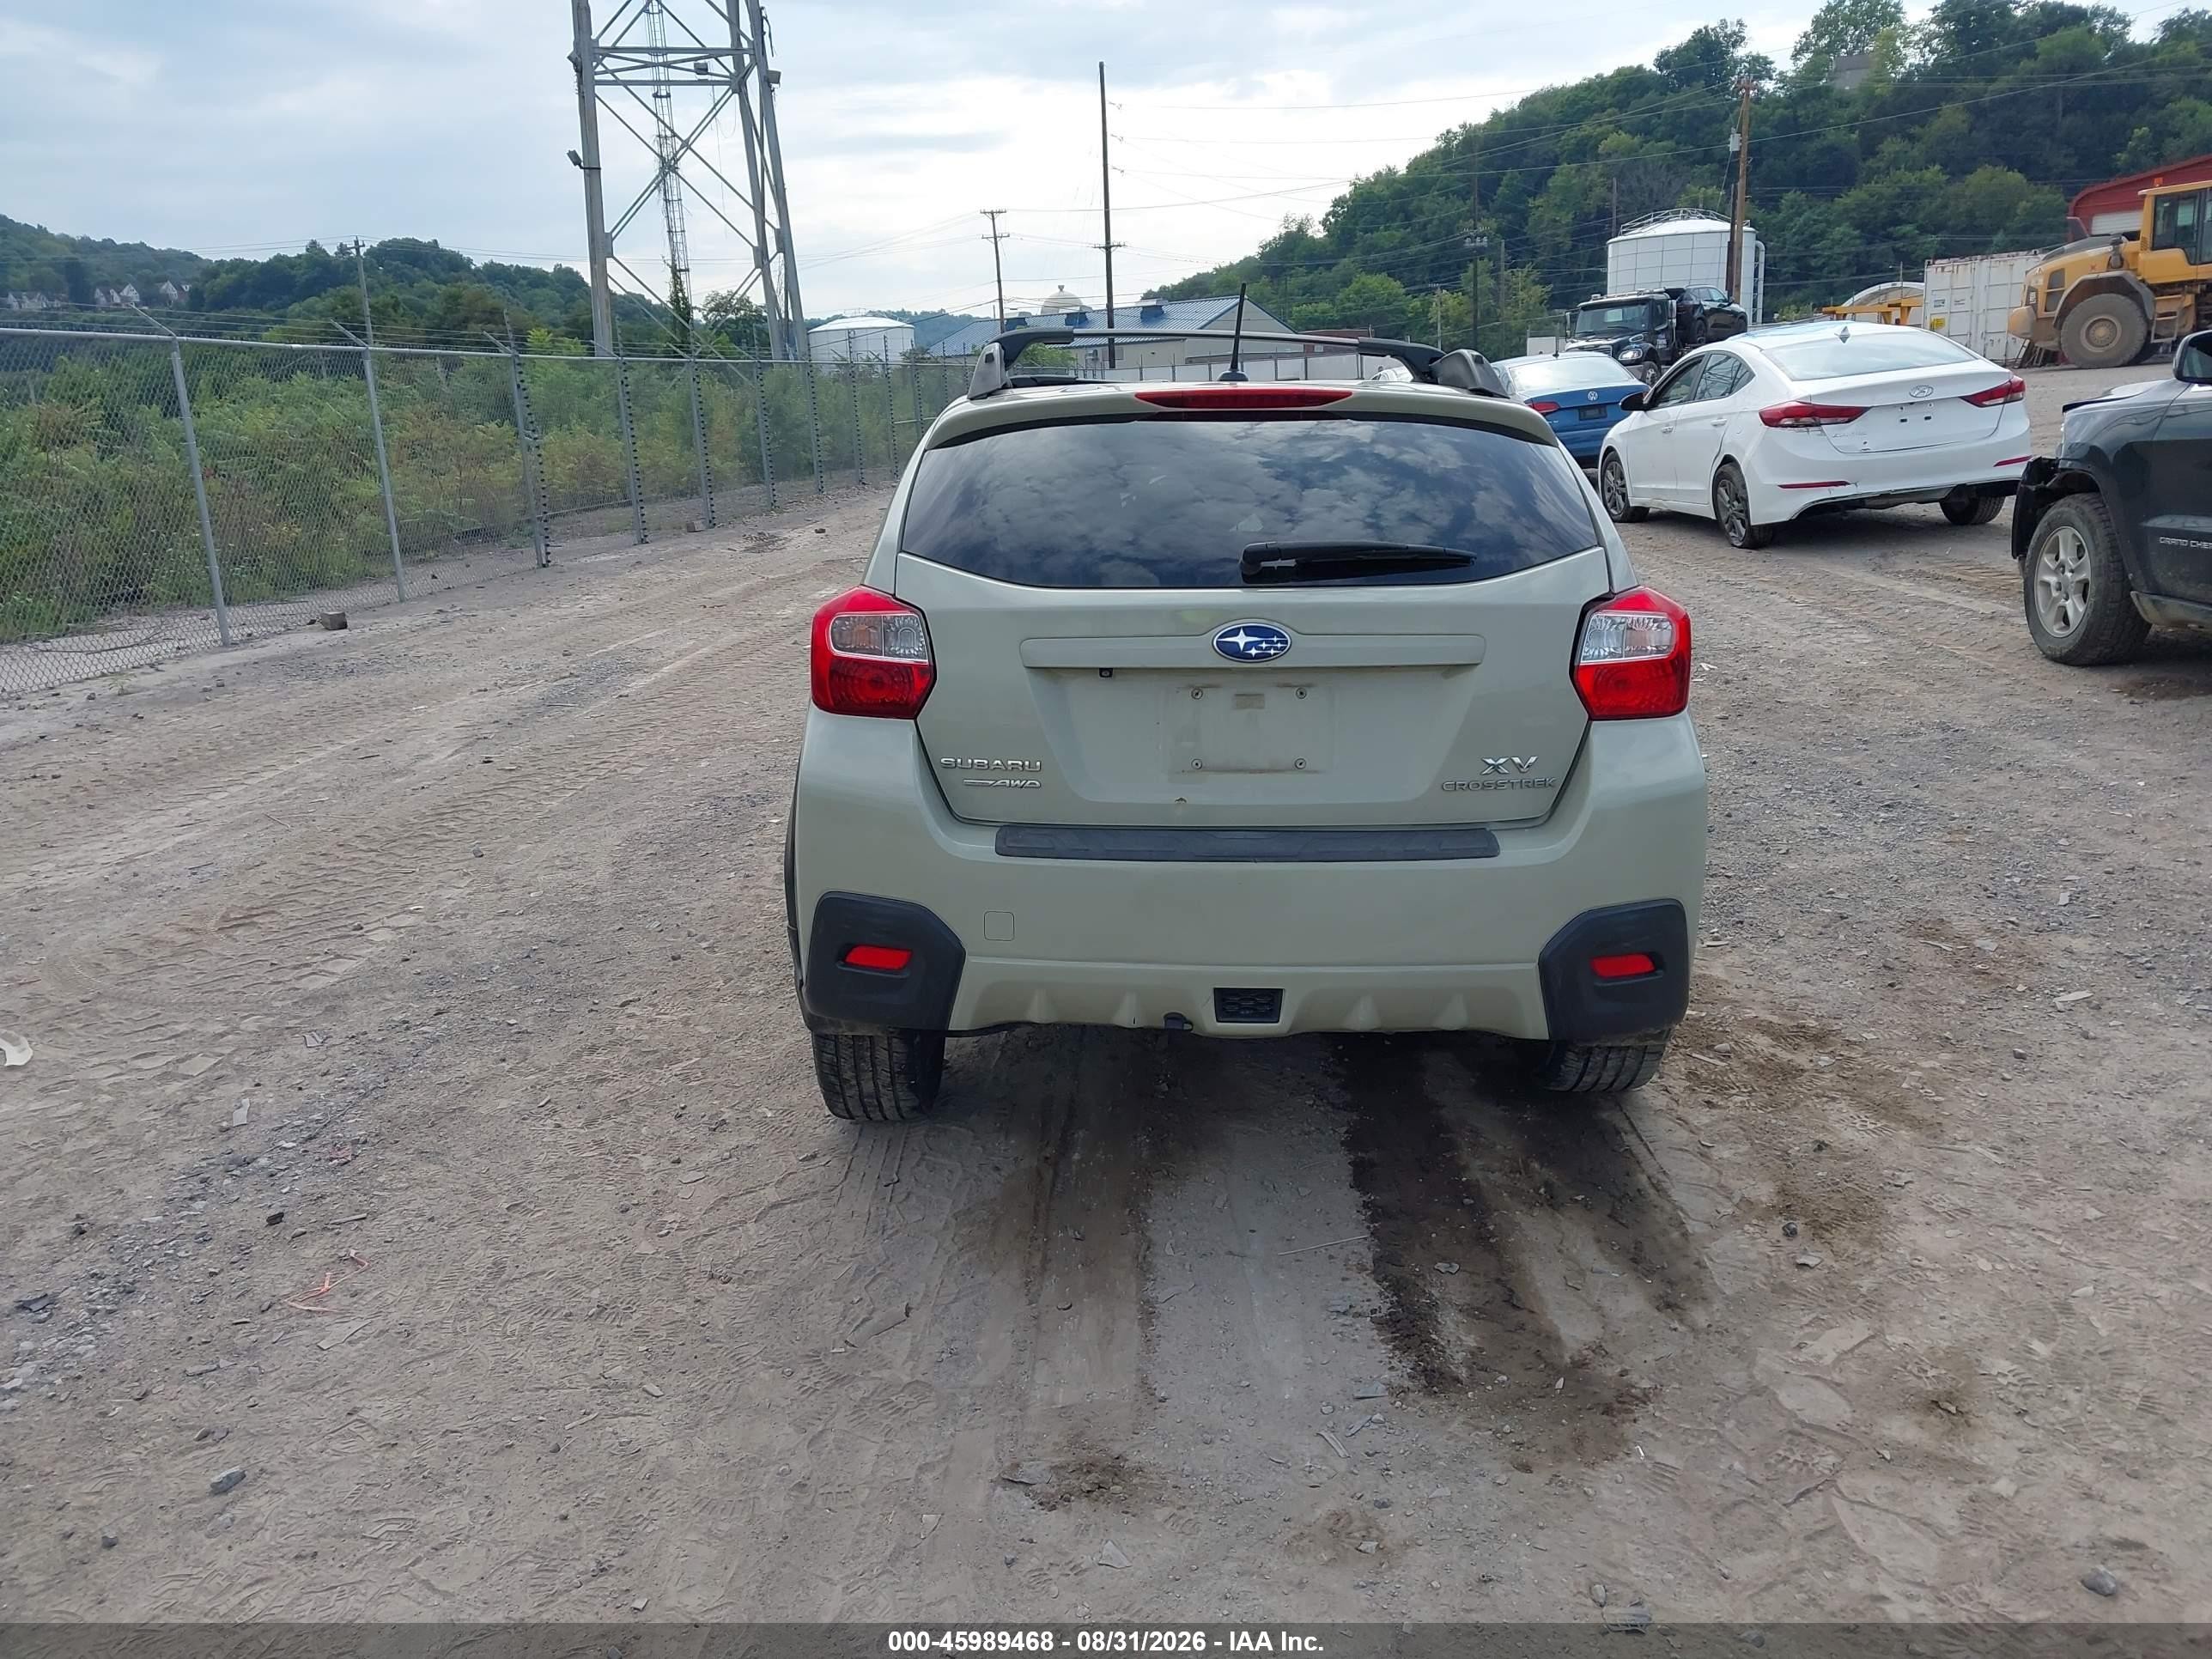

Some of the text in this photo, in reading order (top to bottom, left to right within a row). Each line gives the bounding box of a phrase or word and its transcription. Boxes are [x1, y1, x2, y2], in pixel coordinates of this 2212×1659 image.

[940, 757, 1042, 772] SUBARU
[1479, 755, 1539, 775] XV
[992, 778, 1042, 789] AWD
[1441, 776, 1557, 792] CROSSTREK
